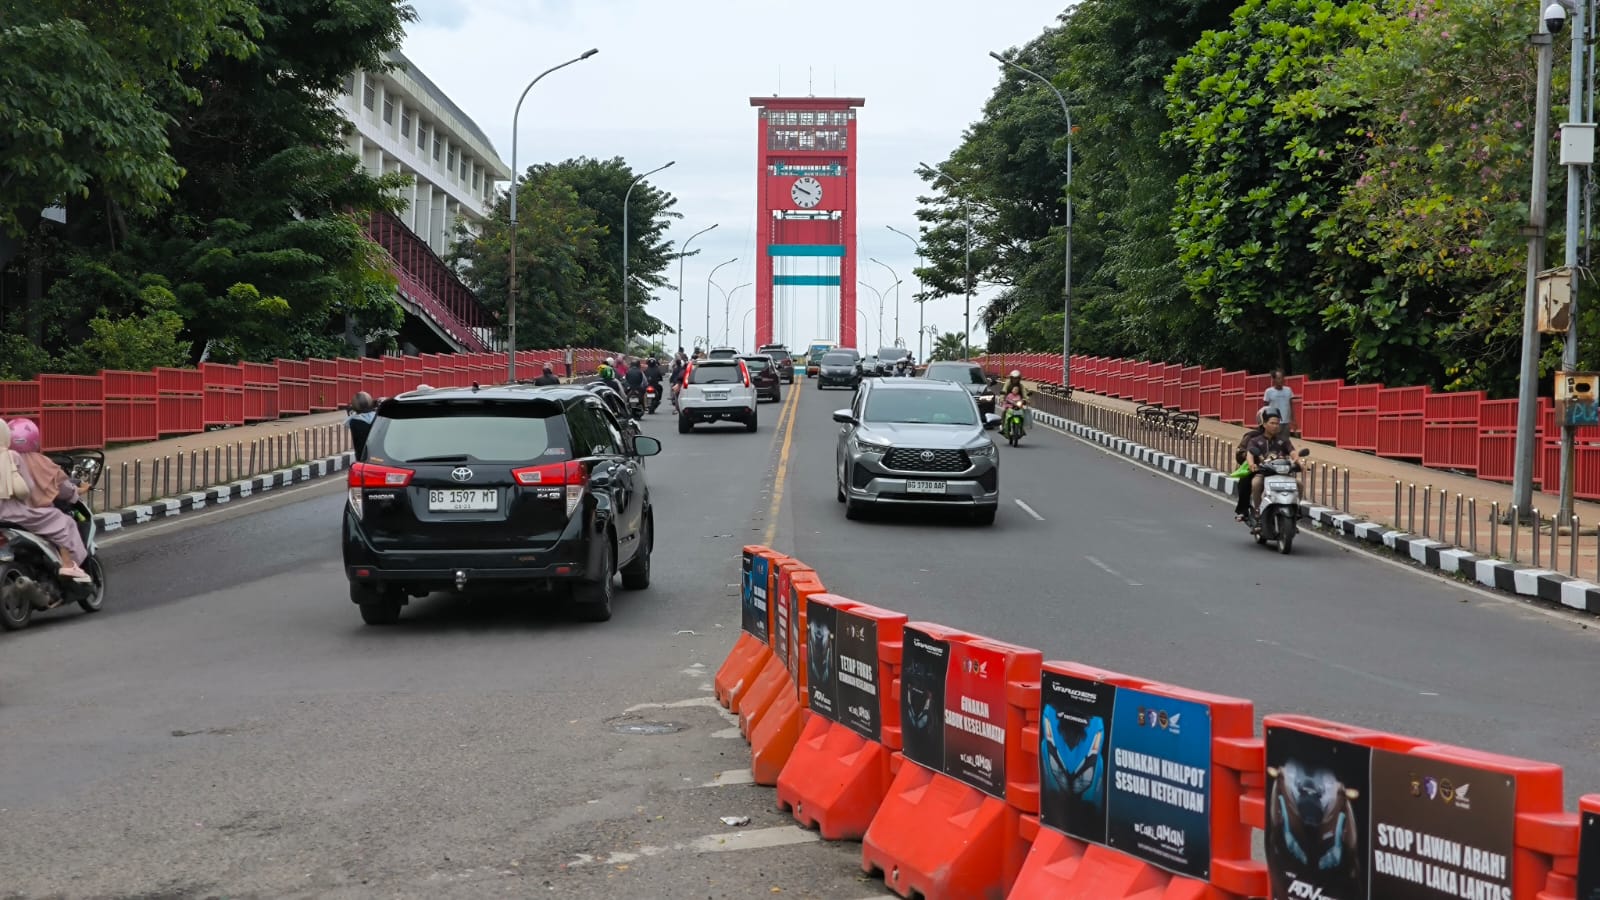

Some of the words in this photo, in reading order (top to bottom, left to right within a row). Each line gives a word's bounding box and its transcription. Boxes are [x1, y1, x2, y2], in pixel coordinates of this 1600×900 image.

[430, 491, 444, 503] BG
[449, 491, 476, 503] 1597
[482, 490, 496, 503] MT
[944, 708, 964, 730] SABUK
[963, 715, 1006, 745] KESELAMATAN
[961, 696, 990, 718] GUNAKAN
[1115, 748, 1160, 776] GUNAKAN
[1161, 759, 1206, 789] KHALPOT
[1115, 770, 1150, 797] SESUAI
[1150, 780, 1205, 814] KETENTUAN
[1377, 823, 1412, 850] STOP
[1416, 832, 1462, 863] LAWAN
[1463, 842, 1507, 880] ARAH!
[1374, 851, 1424, 885] RAWAN
[1425, 863, 1457, 895] LAKA
[1459, 875, 1512, 900] LANTAS
